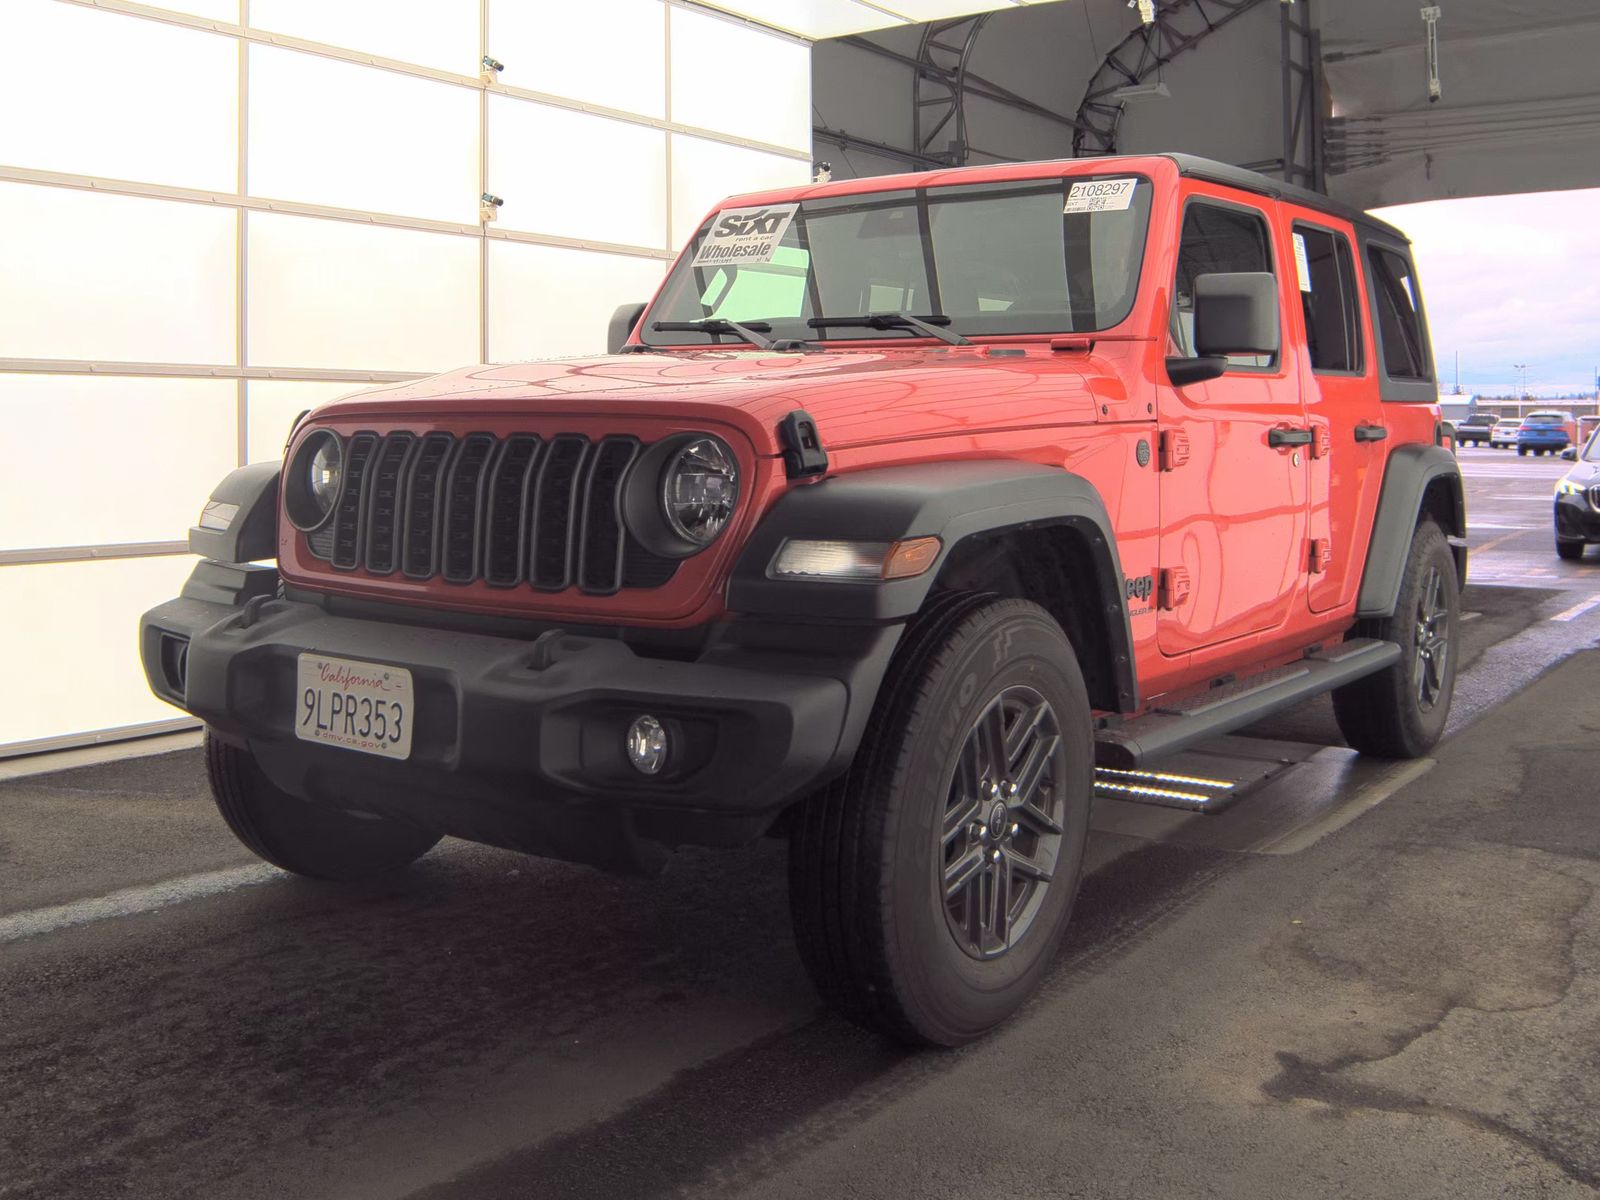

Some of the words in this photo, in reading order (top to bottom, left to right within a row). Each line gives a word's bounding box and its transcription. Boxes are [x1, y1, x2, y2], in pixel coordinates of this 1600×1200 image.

[1070, 183, 1129, 198] 2108297
[700, 242, 771, 259] Wholesale
[320, 663, 388, 691] California
[303, 688, 403, 743] 9LPR353
[322, 732, 380, 748] dmv.ca.gov
